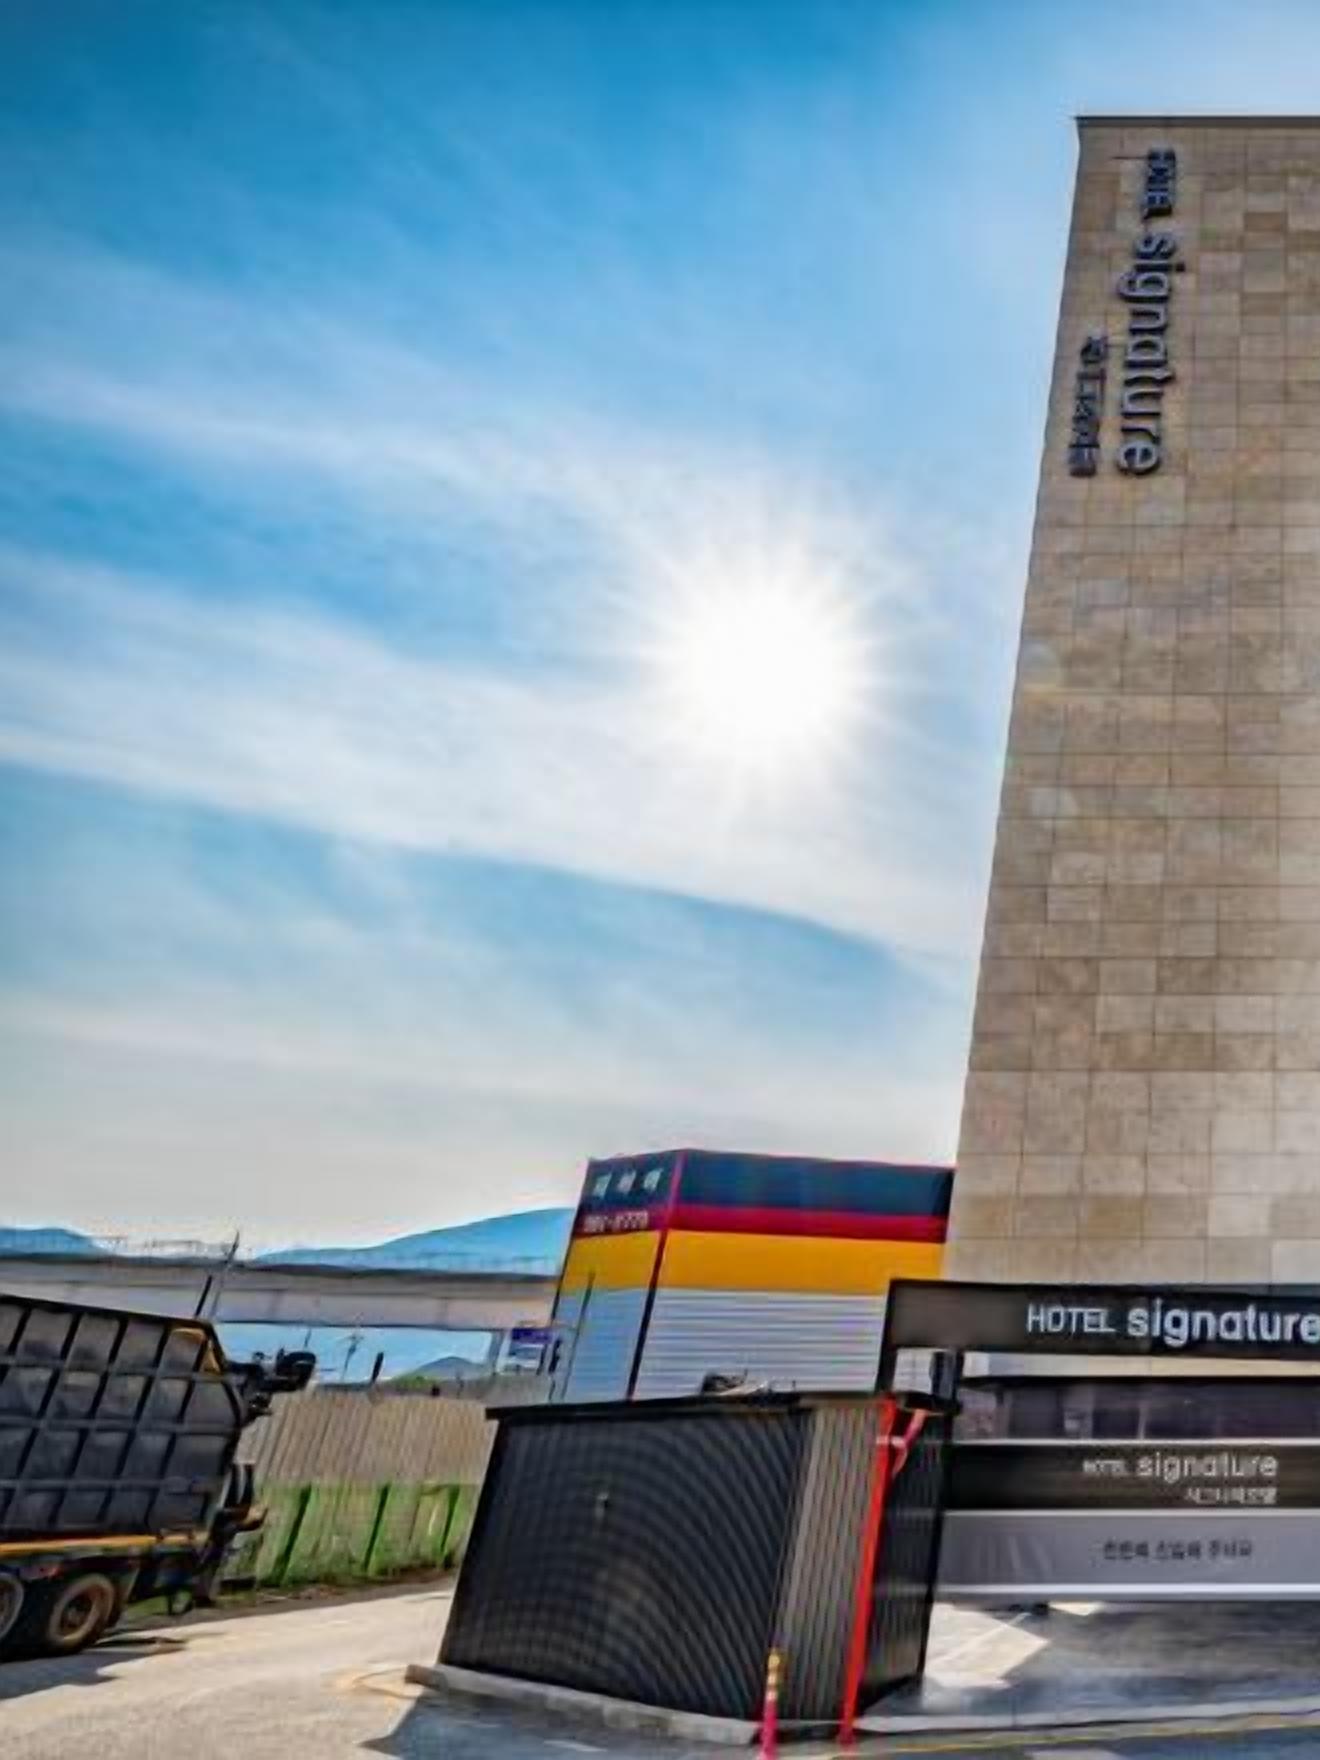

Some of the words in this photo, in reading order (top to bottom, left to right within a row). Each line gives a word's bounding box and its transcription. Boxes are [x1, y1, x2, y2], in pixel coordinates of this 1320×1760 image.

[1116, 230, 1185, 475] signature
[1027, 1303, 1116, 1333] HOTEL
[1136, 1451, 1278, 1484] signature
